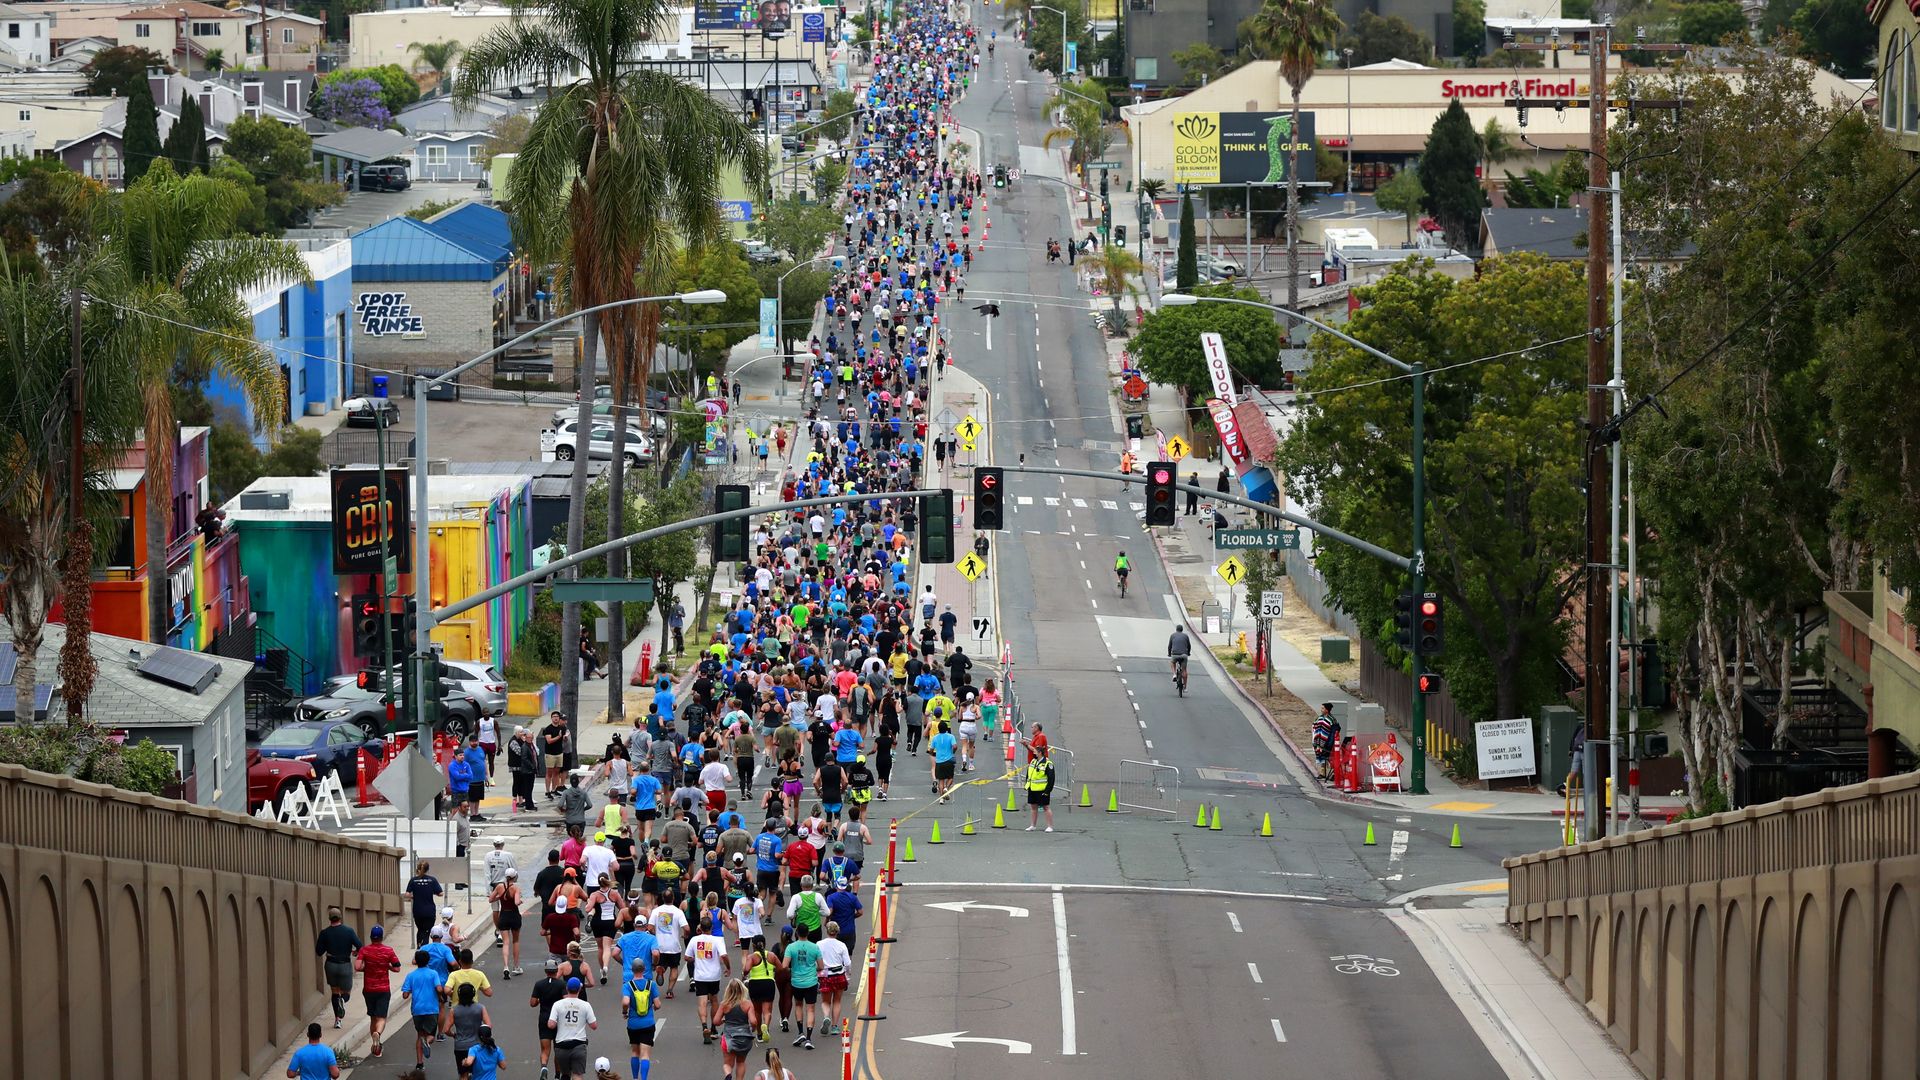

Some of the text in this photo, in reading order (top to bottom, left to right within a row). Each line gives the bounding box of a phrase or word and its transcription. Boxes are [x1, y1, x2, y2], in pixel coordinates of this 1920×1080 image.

[1441, 79, 1508, 98] Smart
[1509, 79, 1523, 98] &
[1525, 78, 1575, 97] Final
[1176, 145, 1217, 155] GOLDN
[1223, 143, 1256, 152] THINK
[1176, 155, 1218, 164] BLOOM
[356, 293, 405, 311] SPOT
[362, 305, 411, 323] FREE
[366, 317, 423, 335] RINSE
[1206, 336, 1232, 403] LIQUOR
[345, 500, 394, 549] CBD
[1221, 533, 1263, 546] FLORIDA
[351, 547, 391, 560] PURE QUALY
[1263, 604, 1281, 616] 30
[565, 1010, 579, 1023] 45
